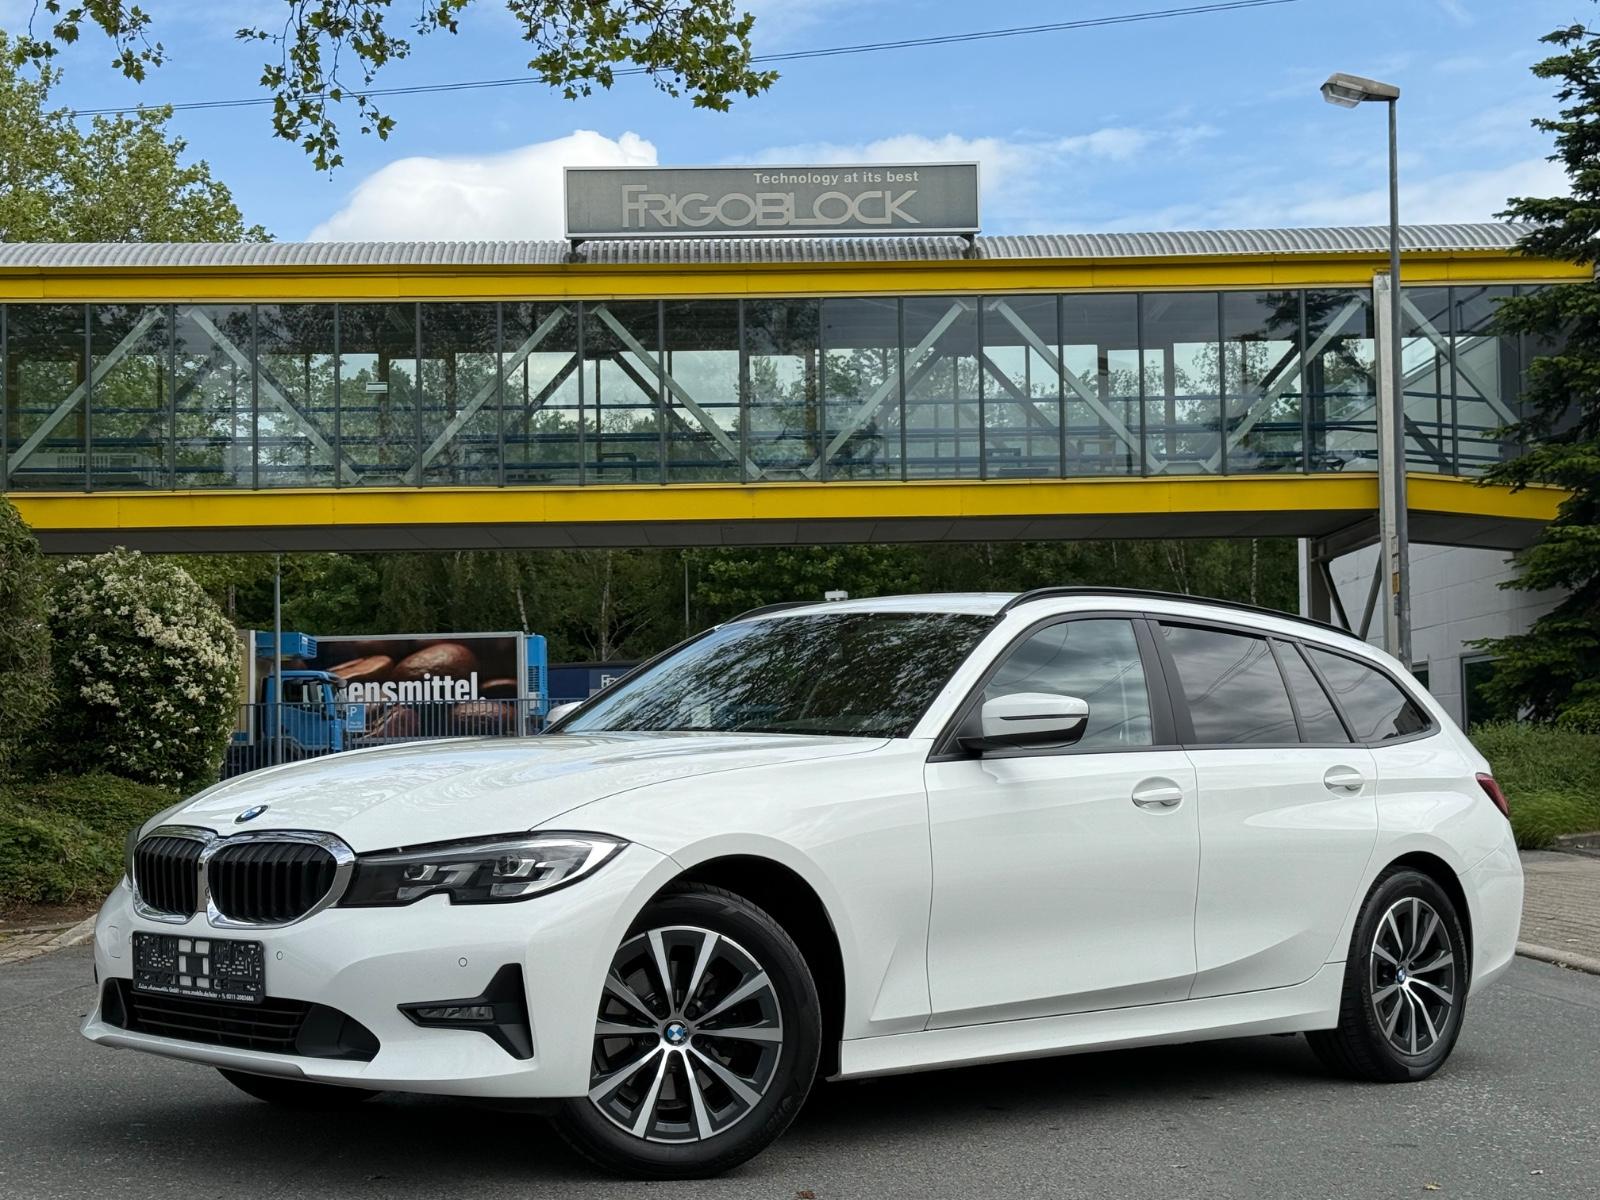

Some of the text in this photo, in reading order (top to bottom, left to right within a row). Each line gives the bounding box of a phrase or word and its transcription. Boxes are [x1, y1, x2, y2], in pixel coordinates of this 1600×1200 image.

[753, 170, 919, 186] Technology at its best
[621, 184, 921, 228] FRIGOBLOCK
